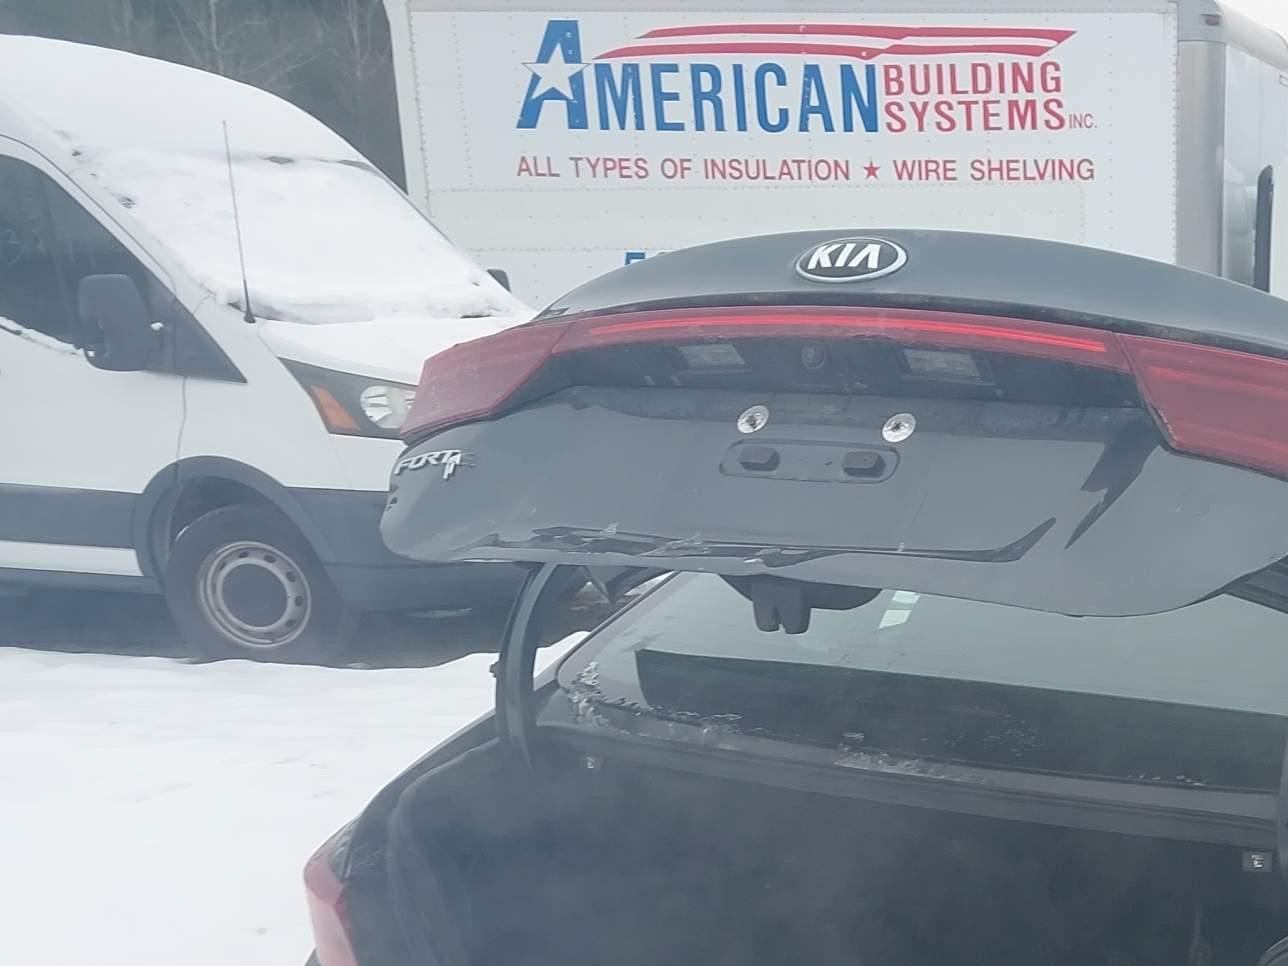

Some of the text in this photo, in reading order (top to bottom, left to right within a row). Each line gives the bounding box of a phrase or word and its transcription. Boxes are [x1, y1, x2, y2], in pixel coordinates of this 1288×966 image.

[516, 20, 1062, 133] AMERICAN BUILDING
[885, 98, 1098, 133] SYSTEMS INC.
[516, 156, 1096, 181] ALL TYPES OF INSULATION WIRE SHELVING
[807, 243, 881, 270] KIA
